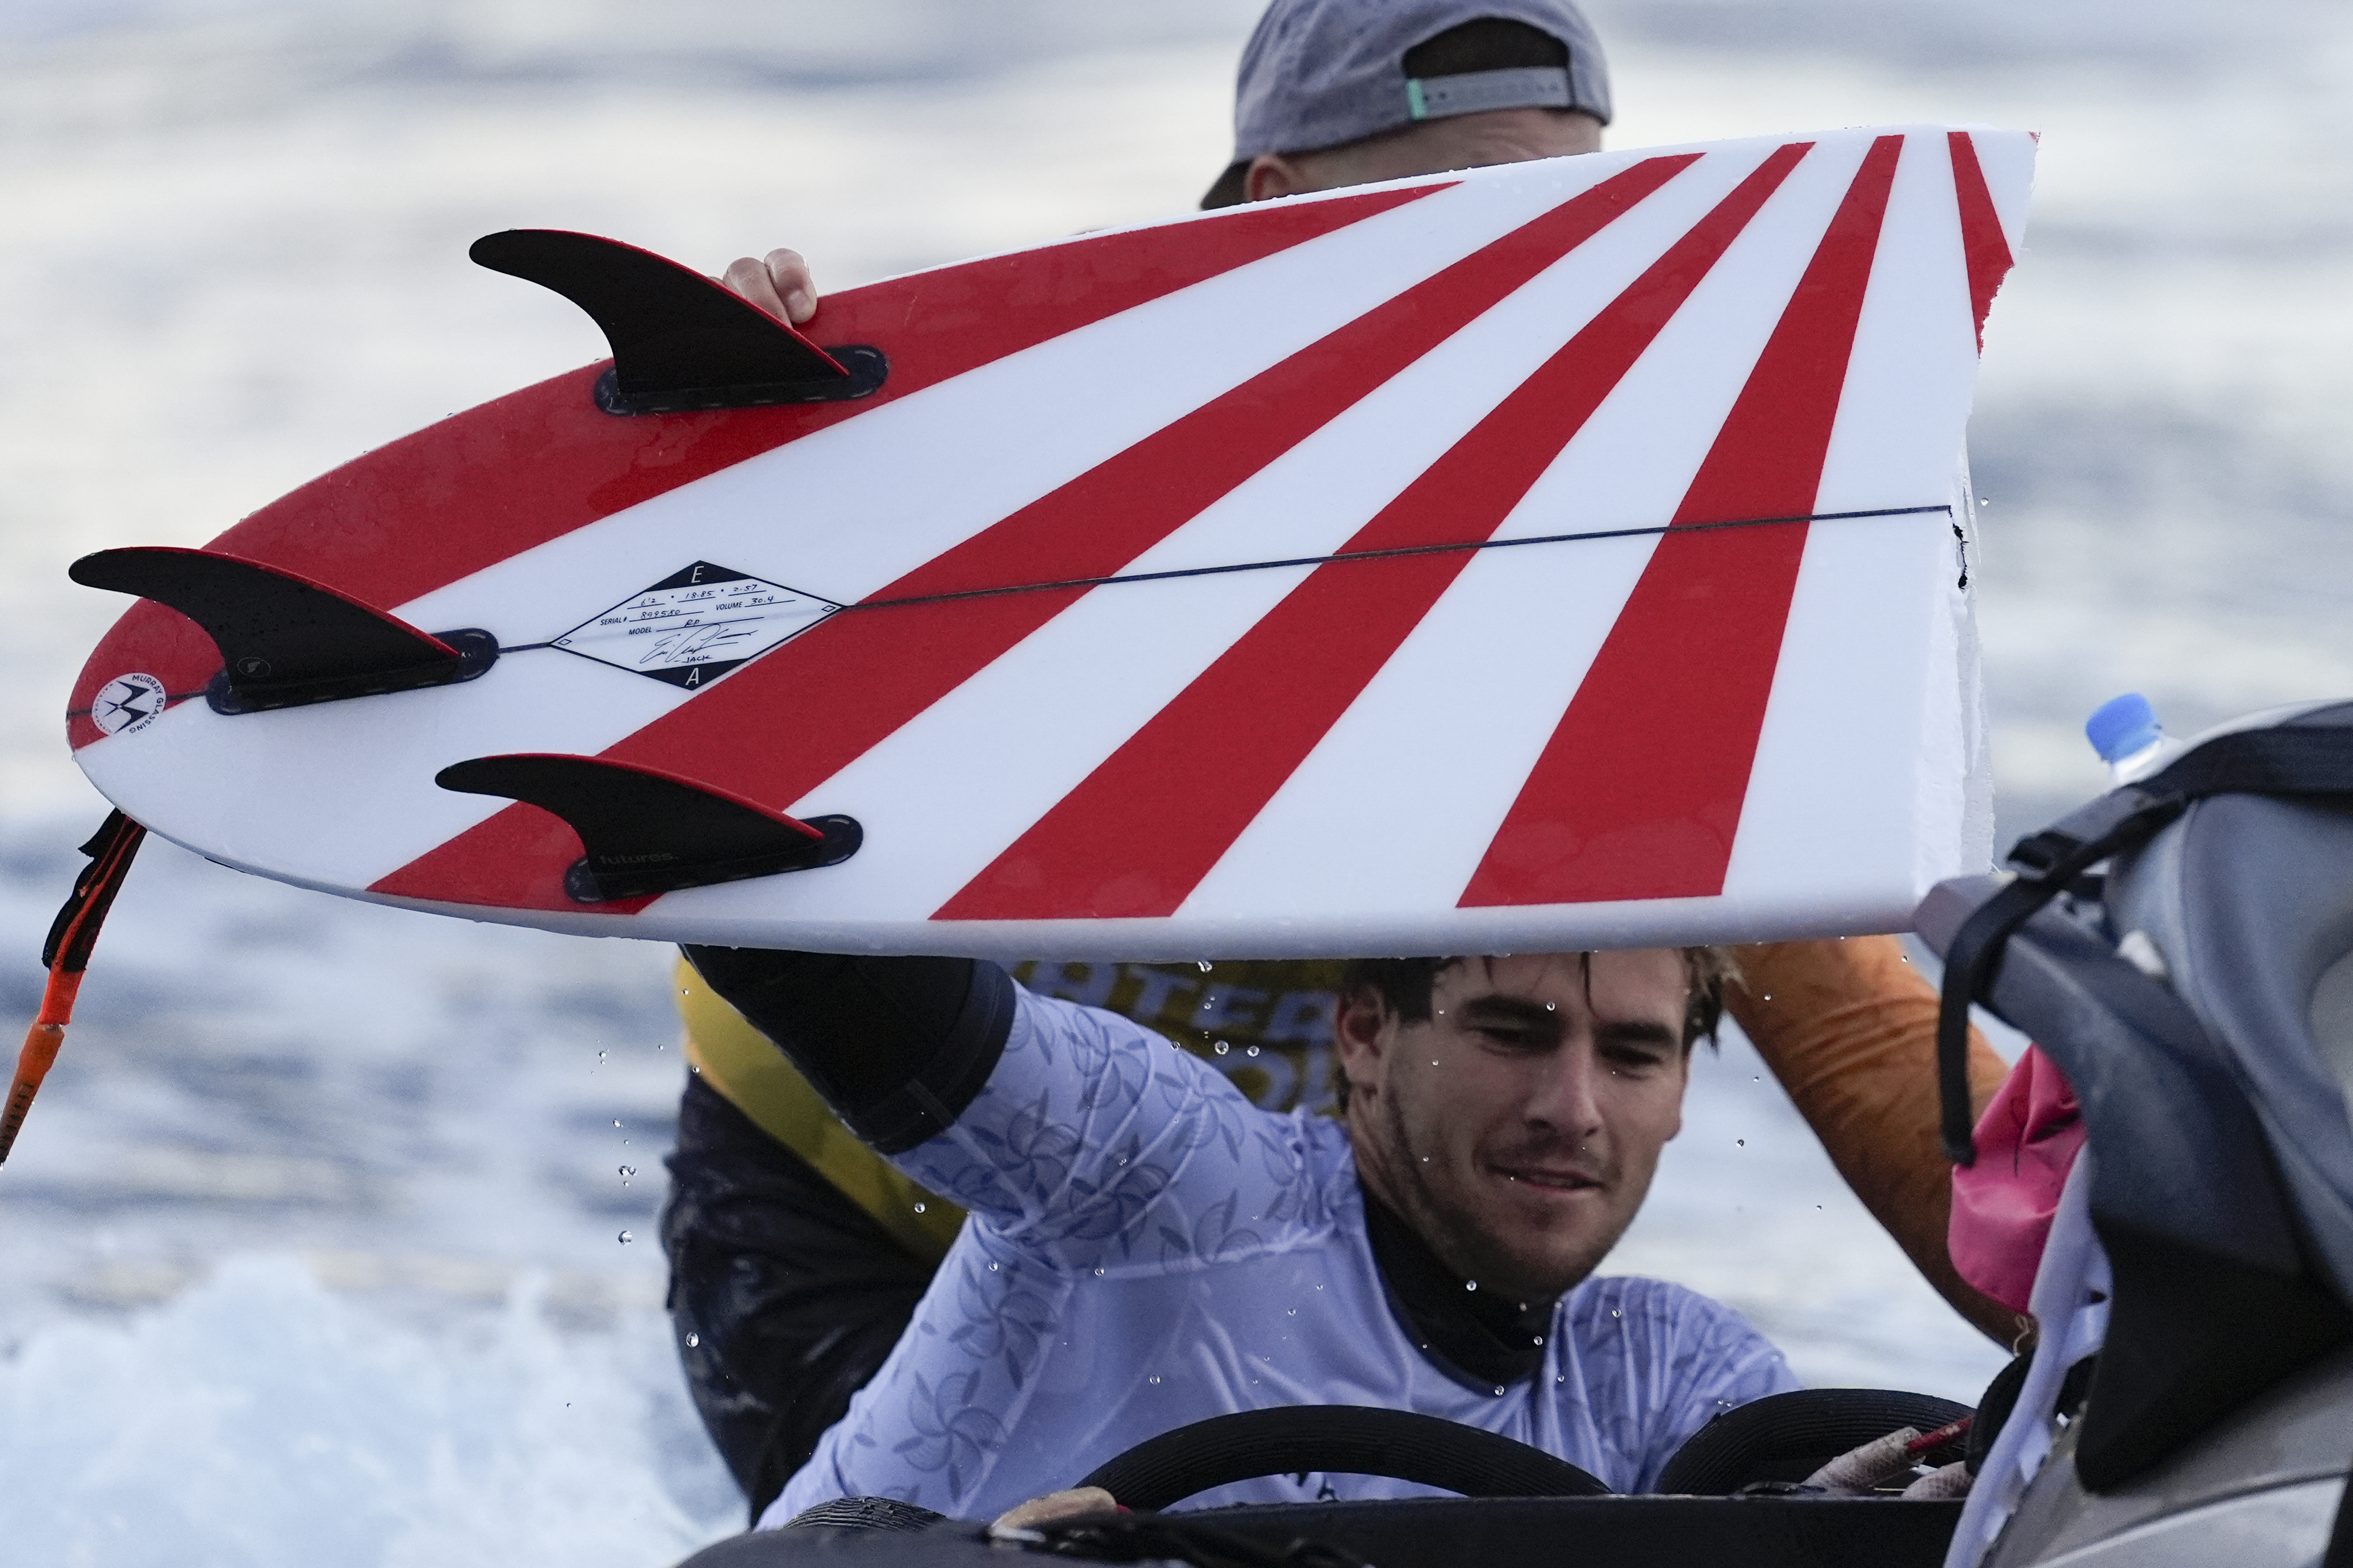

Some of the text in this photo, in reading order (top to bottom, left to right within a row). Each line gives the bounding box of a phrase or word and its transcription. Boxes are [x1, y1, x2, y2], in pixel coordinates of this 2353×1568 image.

[691, 566, 704, 583] E
[716, 595, 774, 611] VOLUME 30.4
[628, 627, 652, 635] MODEL
[685, 667, 699, 685] A
[129, 675, 164, 733] MURRAY GLASSING
